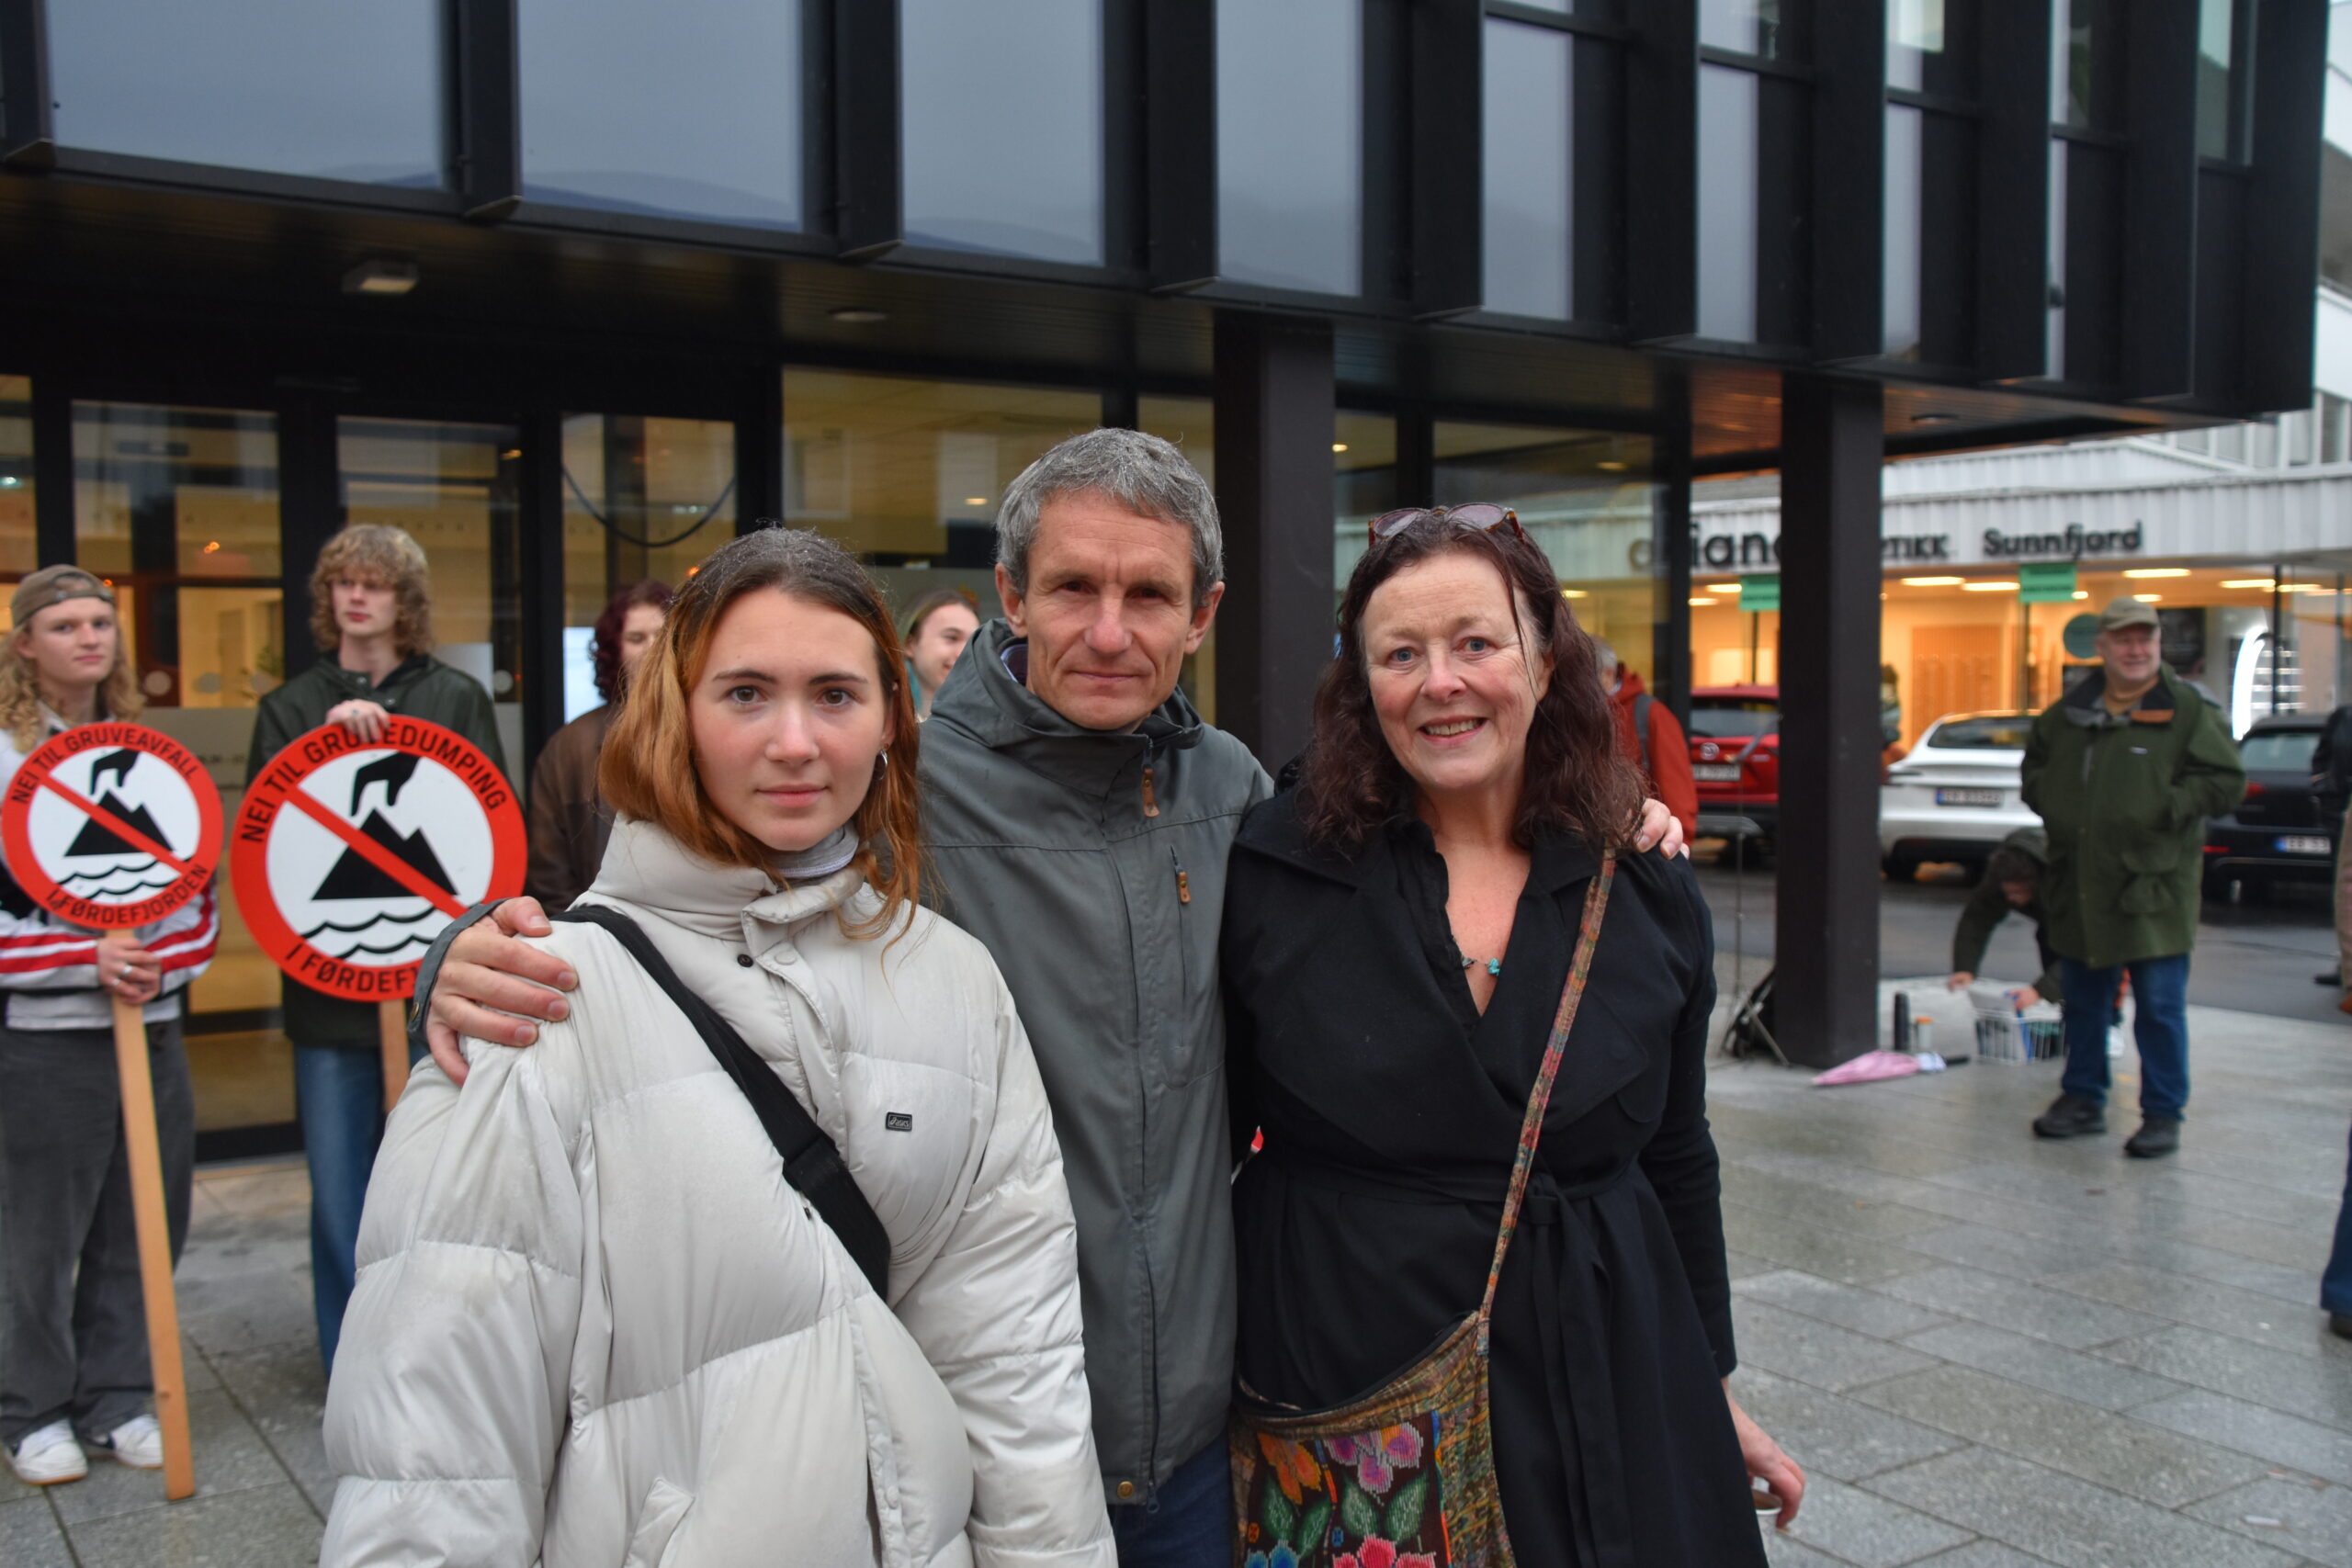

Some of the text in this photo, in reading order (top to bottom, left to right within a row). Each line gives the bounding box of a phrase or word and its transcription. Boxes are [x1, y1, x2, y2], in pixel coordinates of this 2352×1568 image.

[1984, 519, 2143, 560] Sunnfjord
[11, 728, 198, 805] NEI TIL GRUVEAVFALL
[241, 723, 507, 843] NEI TIL GRUEDUMPING
[46, 864, 208, 924] I FØRDEFJORDEN
[284, 942, 300, 962] I
